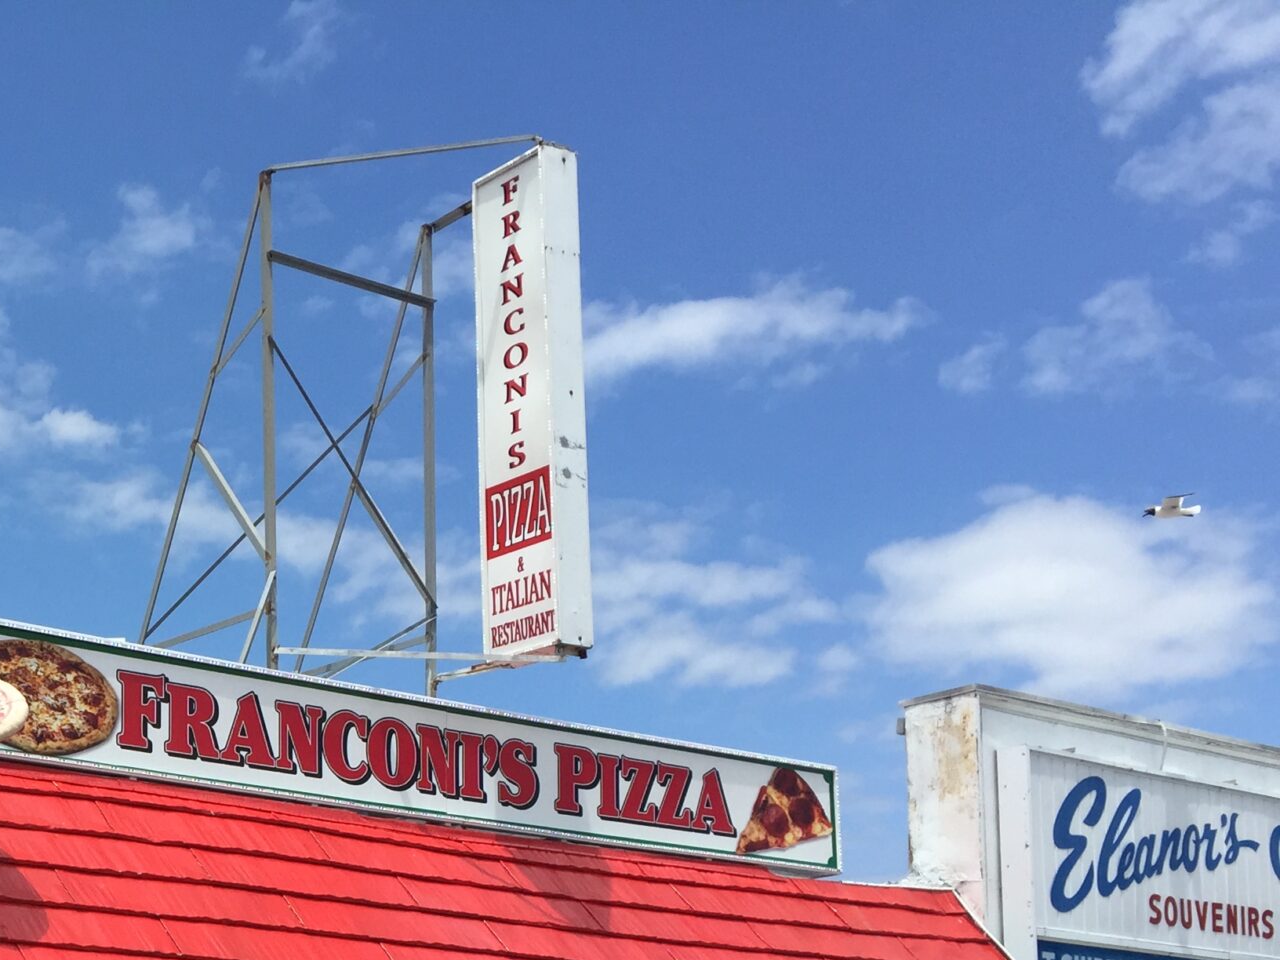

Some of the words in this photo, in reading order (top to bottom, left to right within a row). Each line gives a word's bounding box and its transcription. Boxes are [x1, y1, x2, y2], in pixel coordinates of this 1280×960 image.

[500, 175, 529, 470] FRANCONIS
[490, 475, 551, 552] PIZZA
[491, 569, 552, 616] ITALIAN
[517, 556, 524, 572] &
[491, 609, 555, 649] RESTAURANT
[116, 669, 539, 810] FRANCONI'S
[554, 742, 738, 838] PIZZA
[1050, 776, 1260, 913] Eleanor's
[1149, 893, 1274, 940] SOUVENIRS
